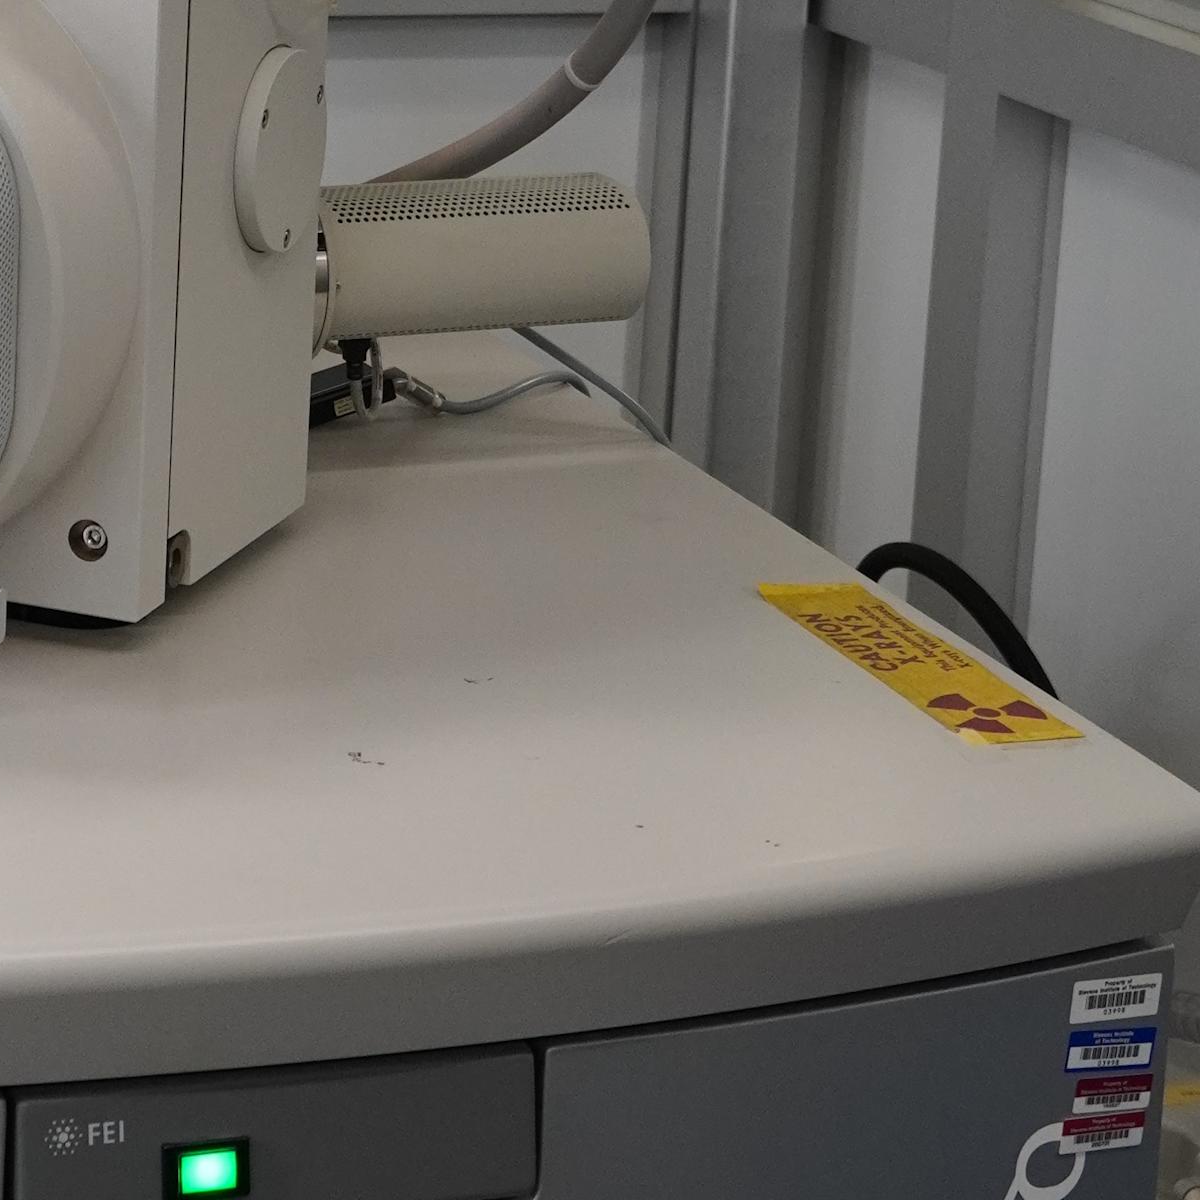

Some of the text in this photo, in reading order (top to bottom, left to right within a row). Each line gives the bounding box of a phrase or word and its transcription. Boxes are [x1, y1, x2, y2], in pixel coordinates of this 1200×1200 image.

[797, 613, 899, 671] CAUTION
[833, 615, 927, 665] X-RAYS
[87, 1119, 125, 1147] FEI
